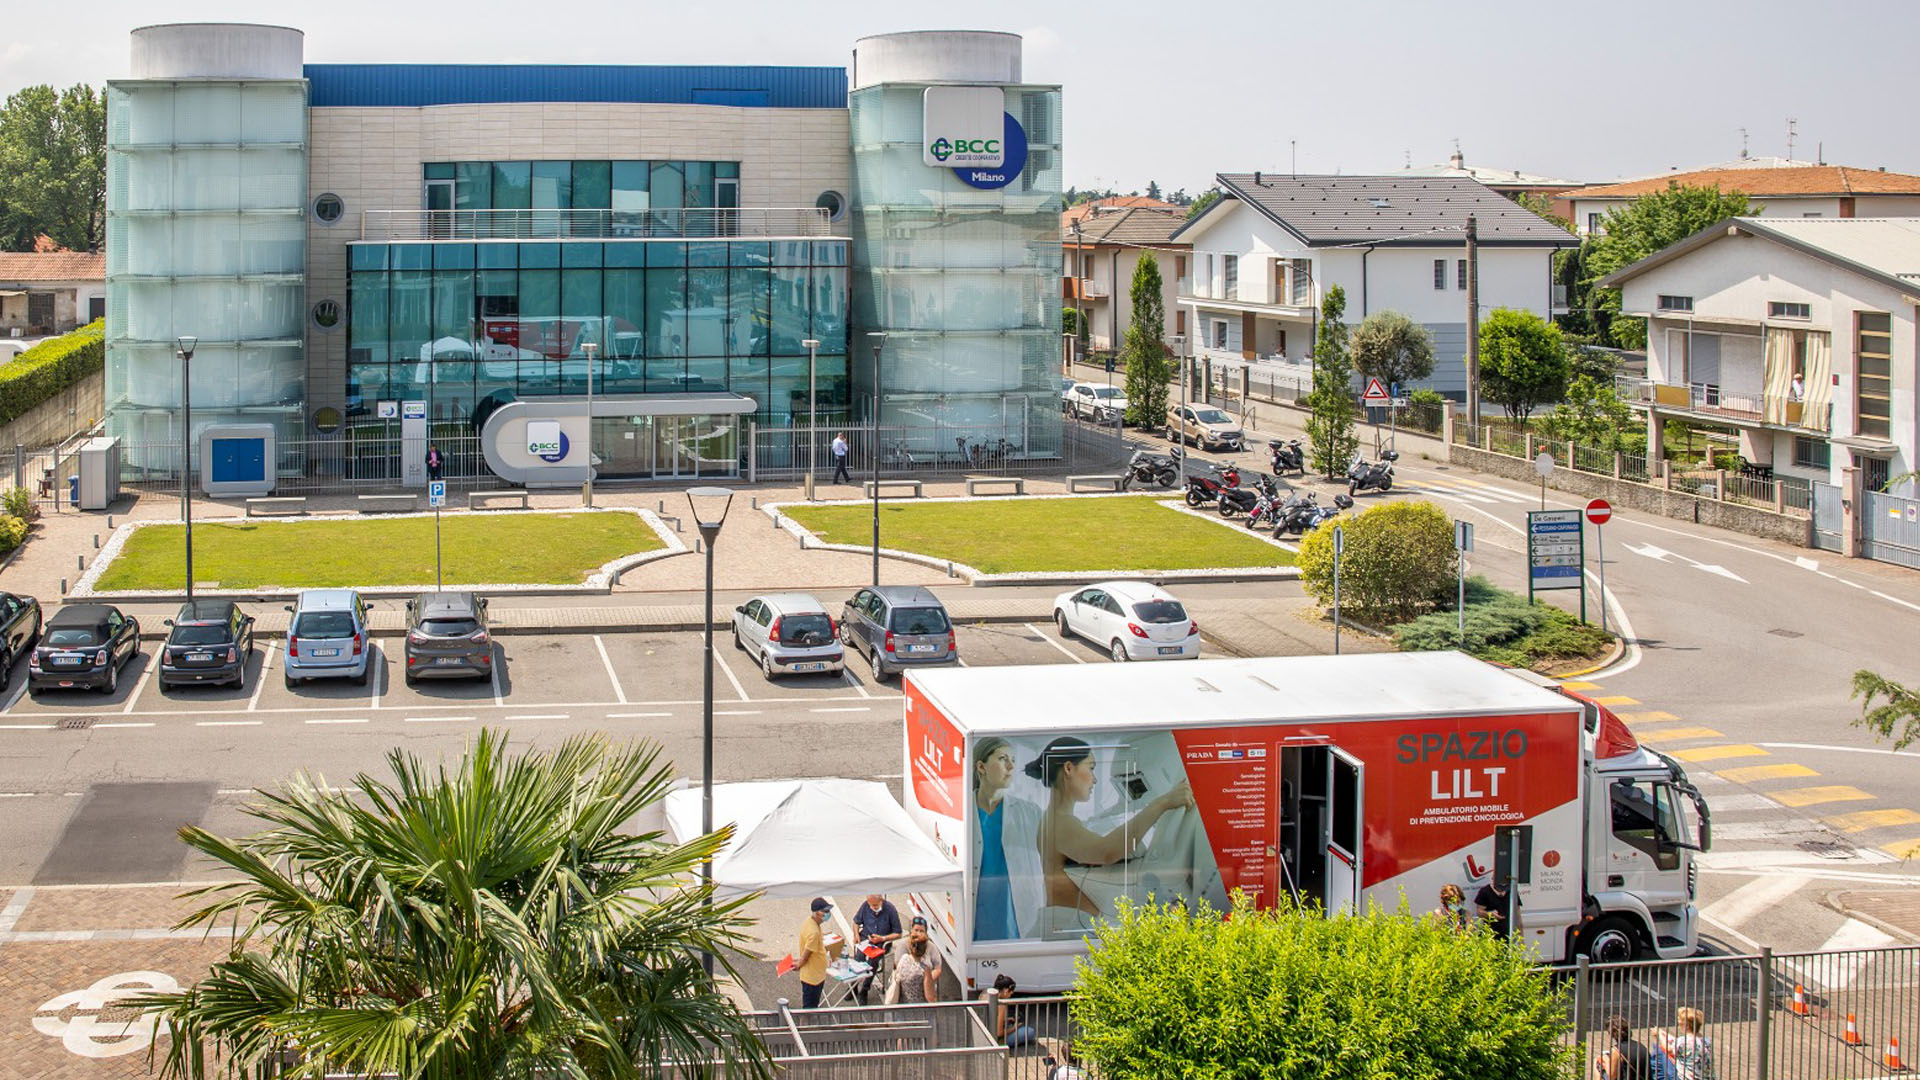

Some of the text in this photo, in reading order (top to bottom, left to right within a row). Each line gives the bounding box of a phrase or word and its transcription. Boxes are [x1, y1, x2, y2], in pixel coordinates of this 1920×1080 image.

[955, 139, 1000, 153] BCC
[972, 172, 1005, 182] Milano
[923, 734, 944, 772] LILT
[1396, 728, 1529, 764] SPAZIO
[1186, 751, 1214, 759] PRADA
[1431, 767, 1506, 800] LILT
[1423, 803, 1509, 816] AMBULATORIO MOBILE
[1409, 811, 1524, 826] DI PREVENZIONE ONCOLOGICA
